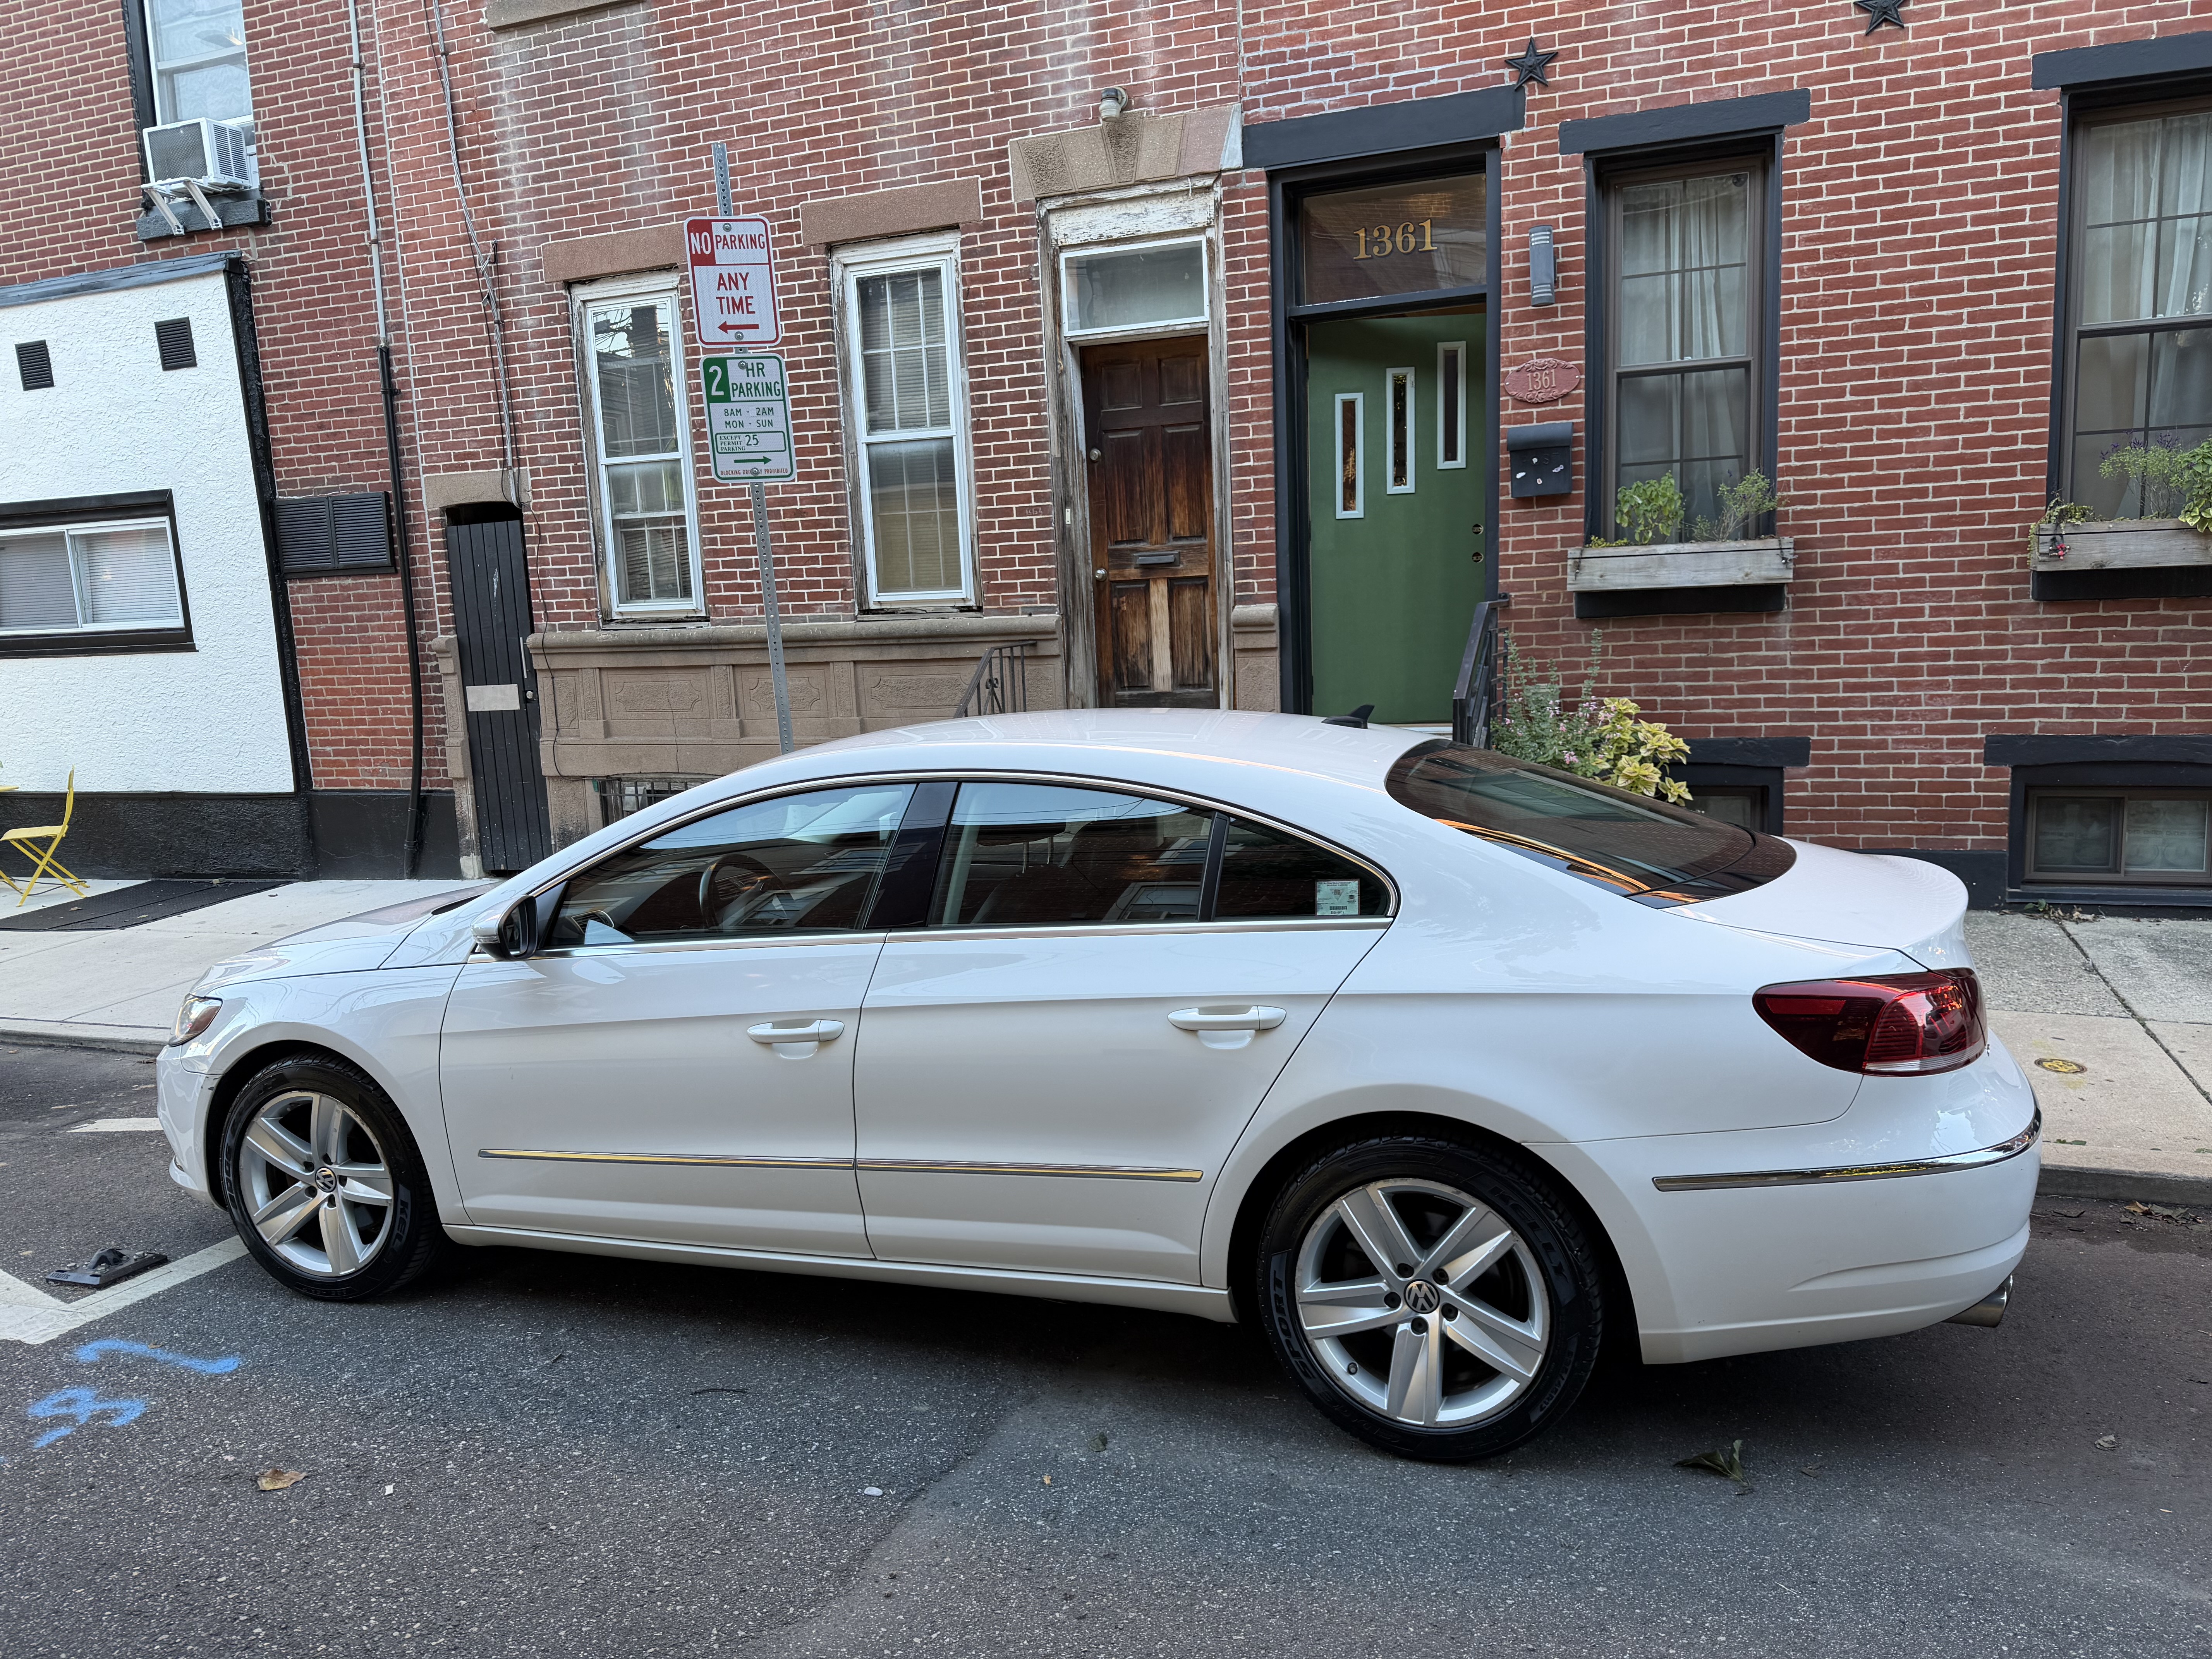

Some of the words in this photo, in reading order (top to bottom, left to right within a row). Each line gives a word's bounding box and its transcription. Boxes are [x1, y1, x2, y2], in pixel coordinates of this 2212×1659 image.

[690, 232, 711, 254] NO
[715, 233, 766, 250] PARKING
[1353, 218, 1438, 259] 1361
[717, 272, 749, 291] ANY
[716, 295, 756, 315] TIME
[709, 365, 724, 396] 2
[746, 362, 766, 378] HR
[731, 381, 781, 398] PARKING
[1527, 369, 1556, 391] 1361
[724, 409, 742, 417] 8AM
[756, 407, 774, 416] 2AM
[725, 421, 744, 429] MON
[756, 419, 773, 428] SUN
[745, 434, 760, 447] 25
[1487, 1185, 1568, 1283] KELLY
[1273, 1269, 1317, 1381] SPORT
